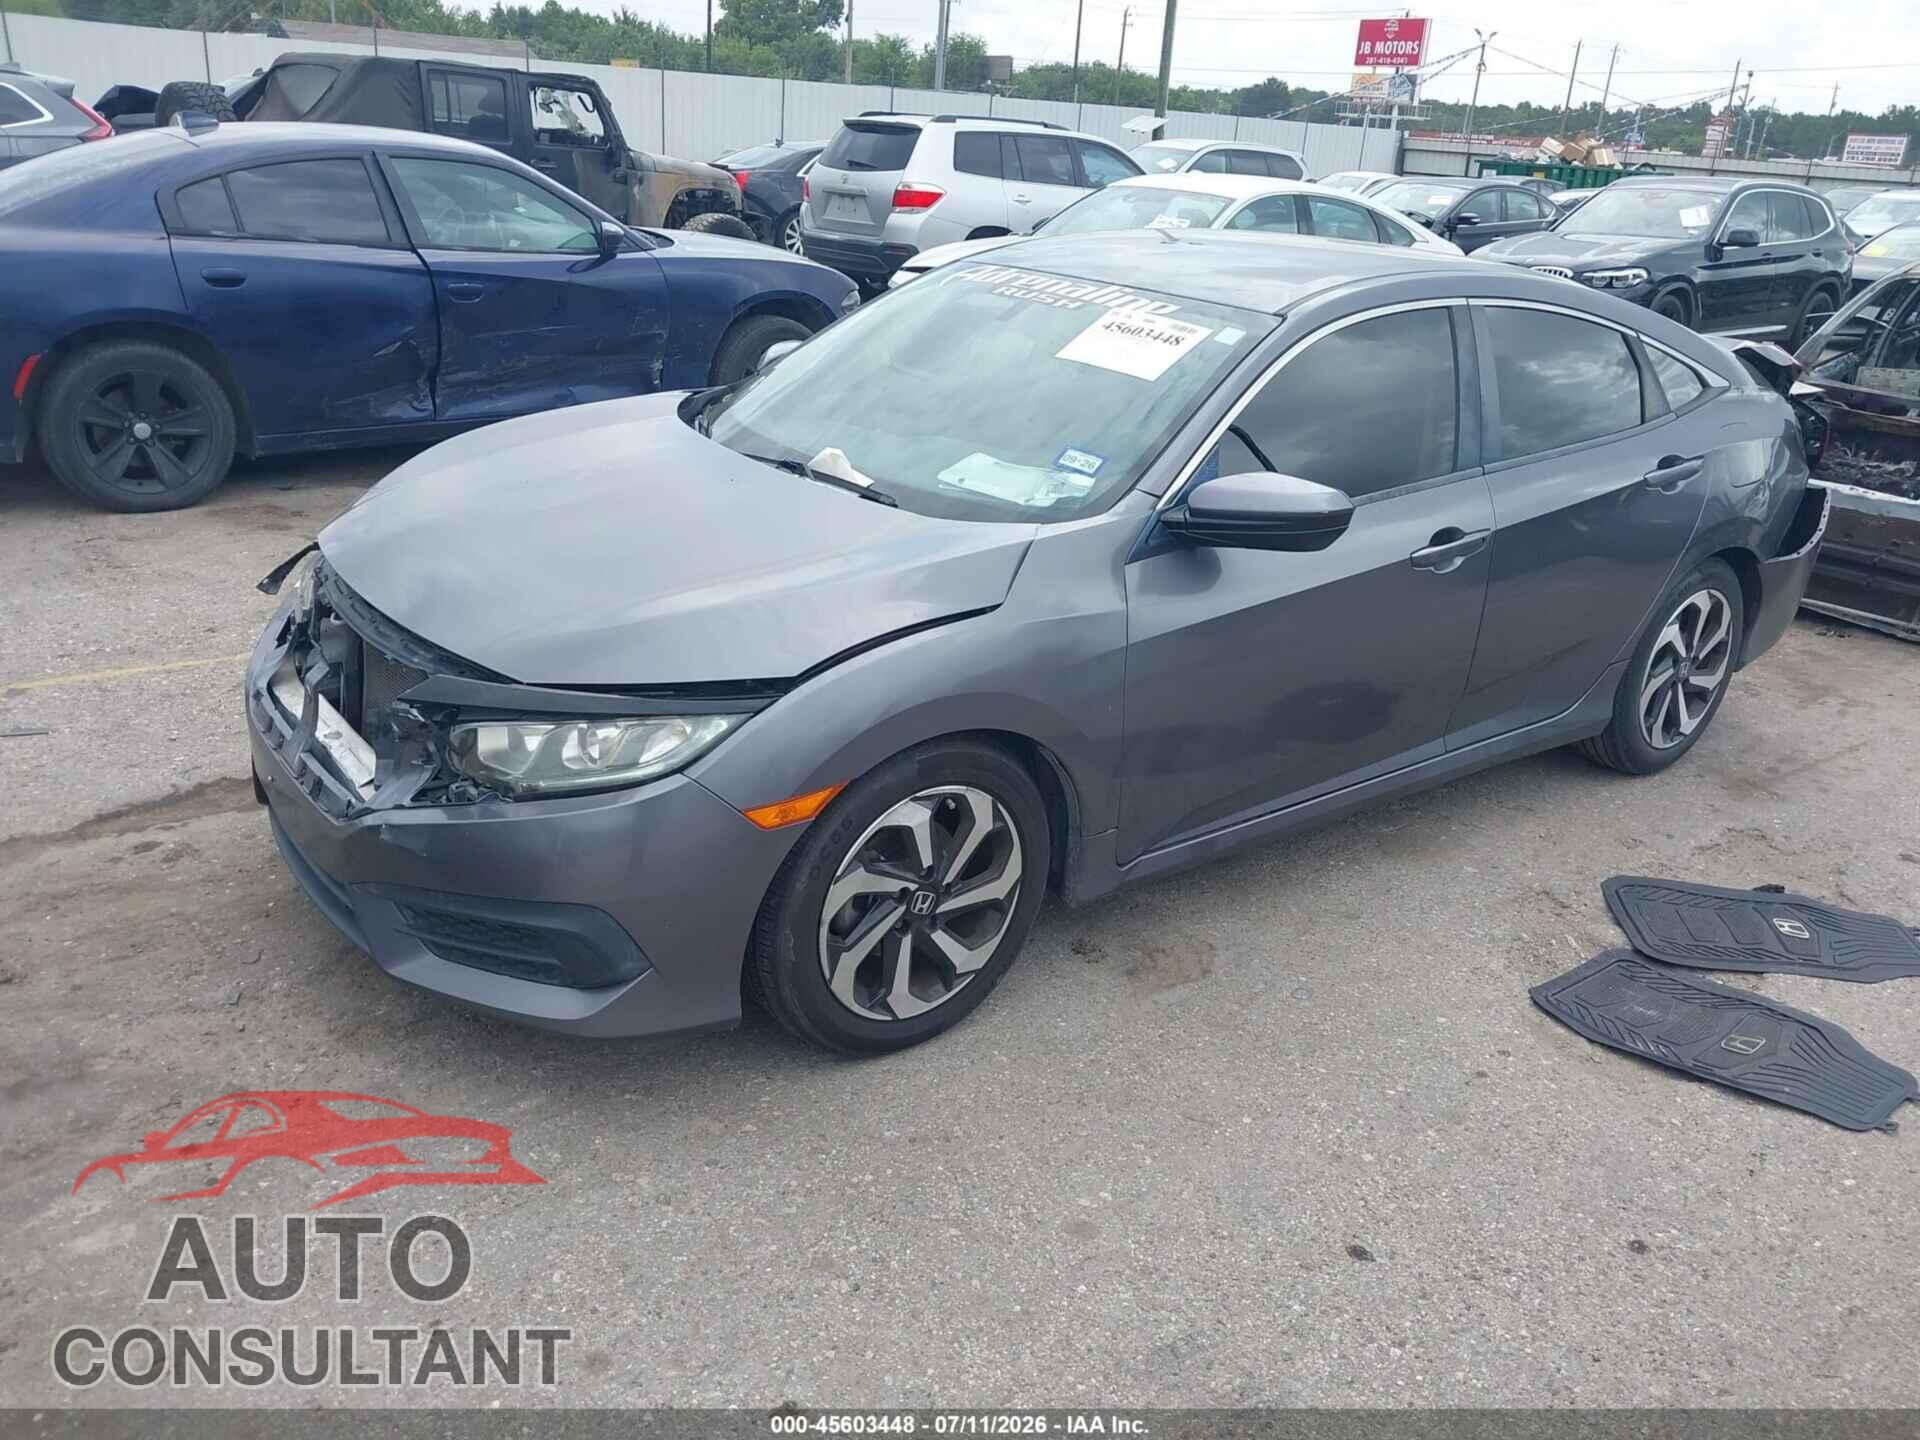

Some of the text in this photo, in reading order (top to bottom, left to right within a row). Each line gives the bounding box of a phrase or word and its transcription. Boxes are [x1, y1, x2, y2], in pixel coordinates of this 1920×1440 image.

[1358, 41, 1420, 55] JB MOTORS
[992, 286, 1084, 310] RUSH
[1102, 320, 1185, 346] 45603448
